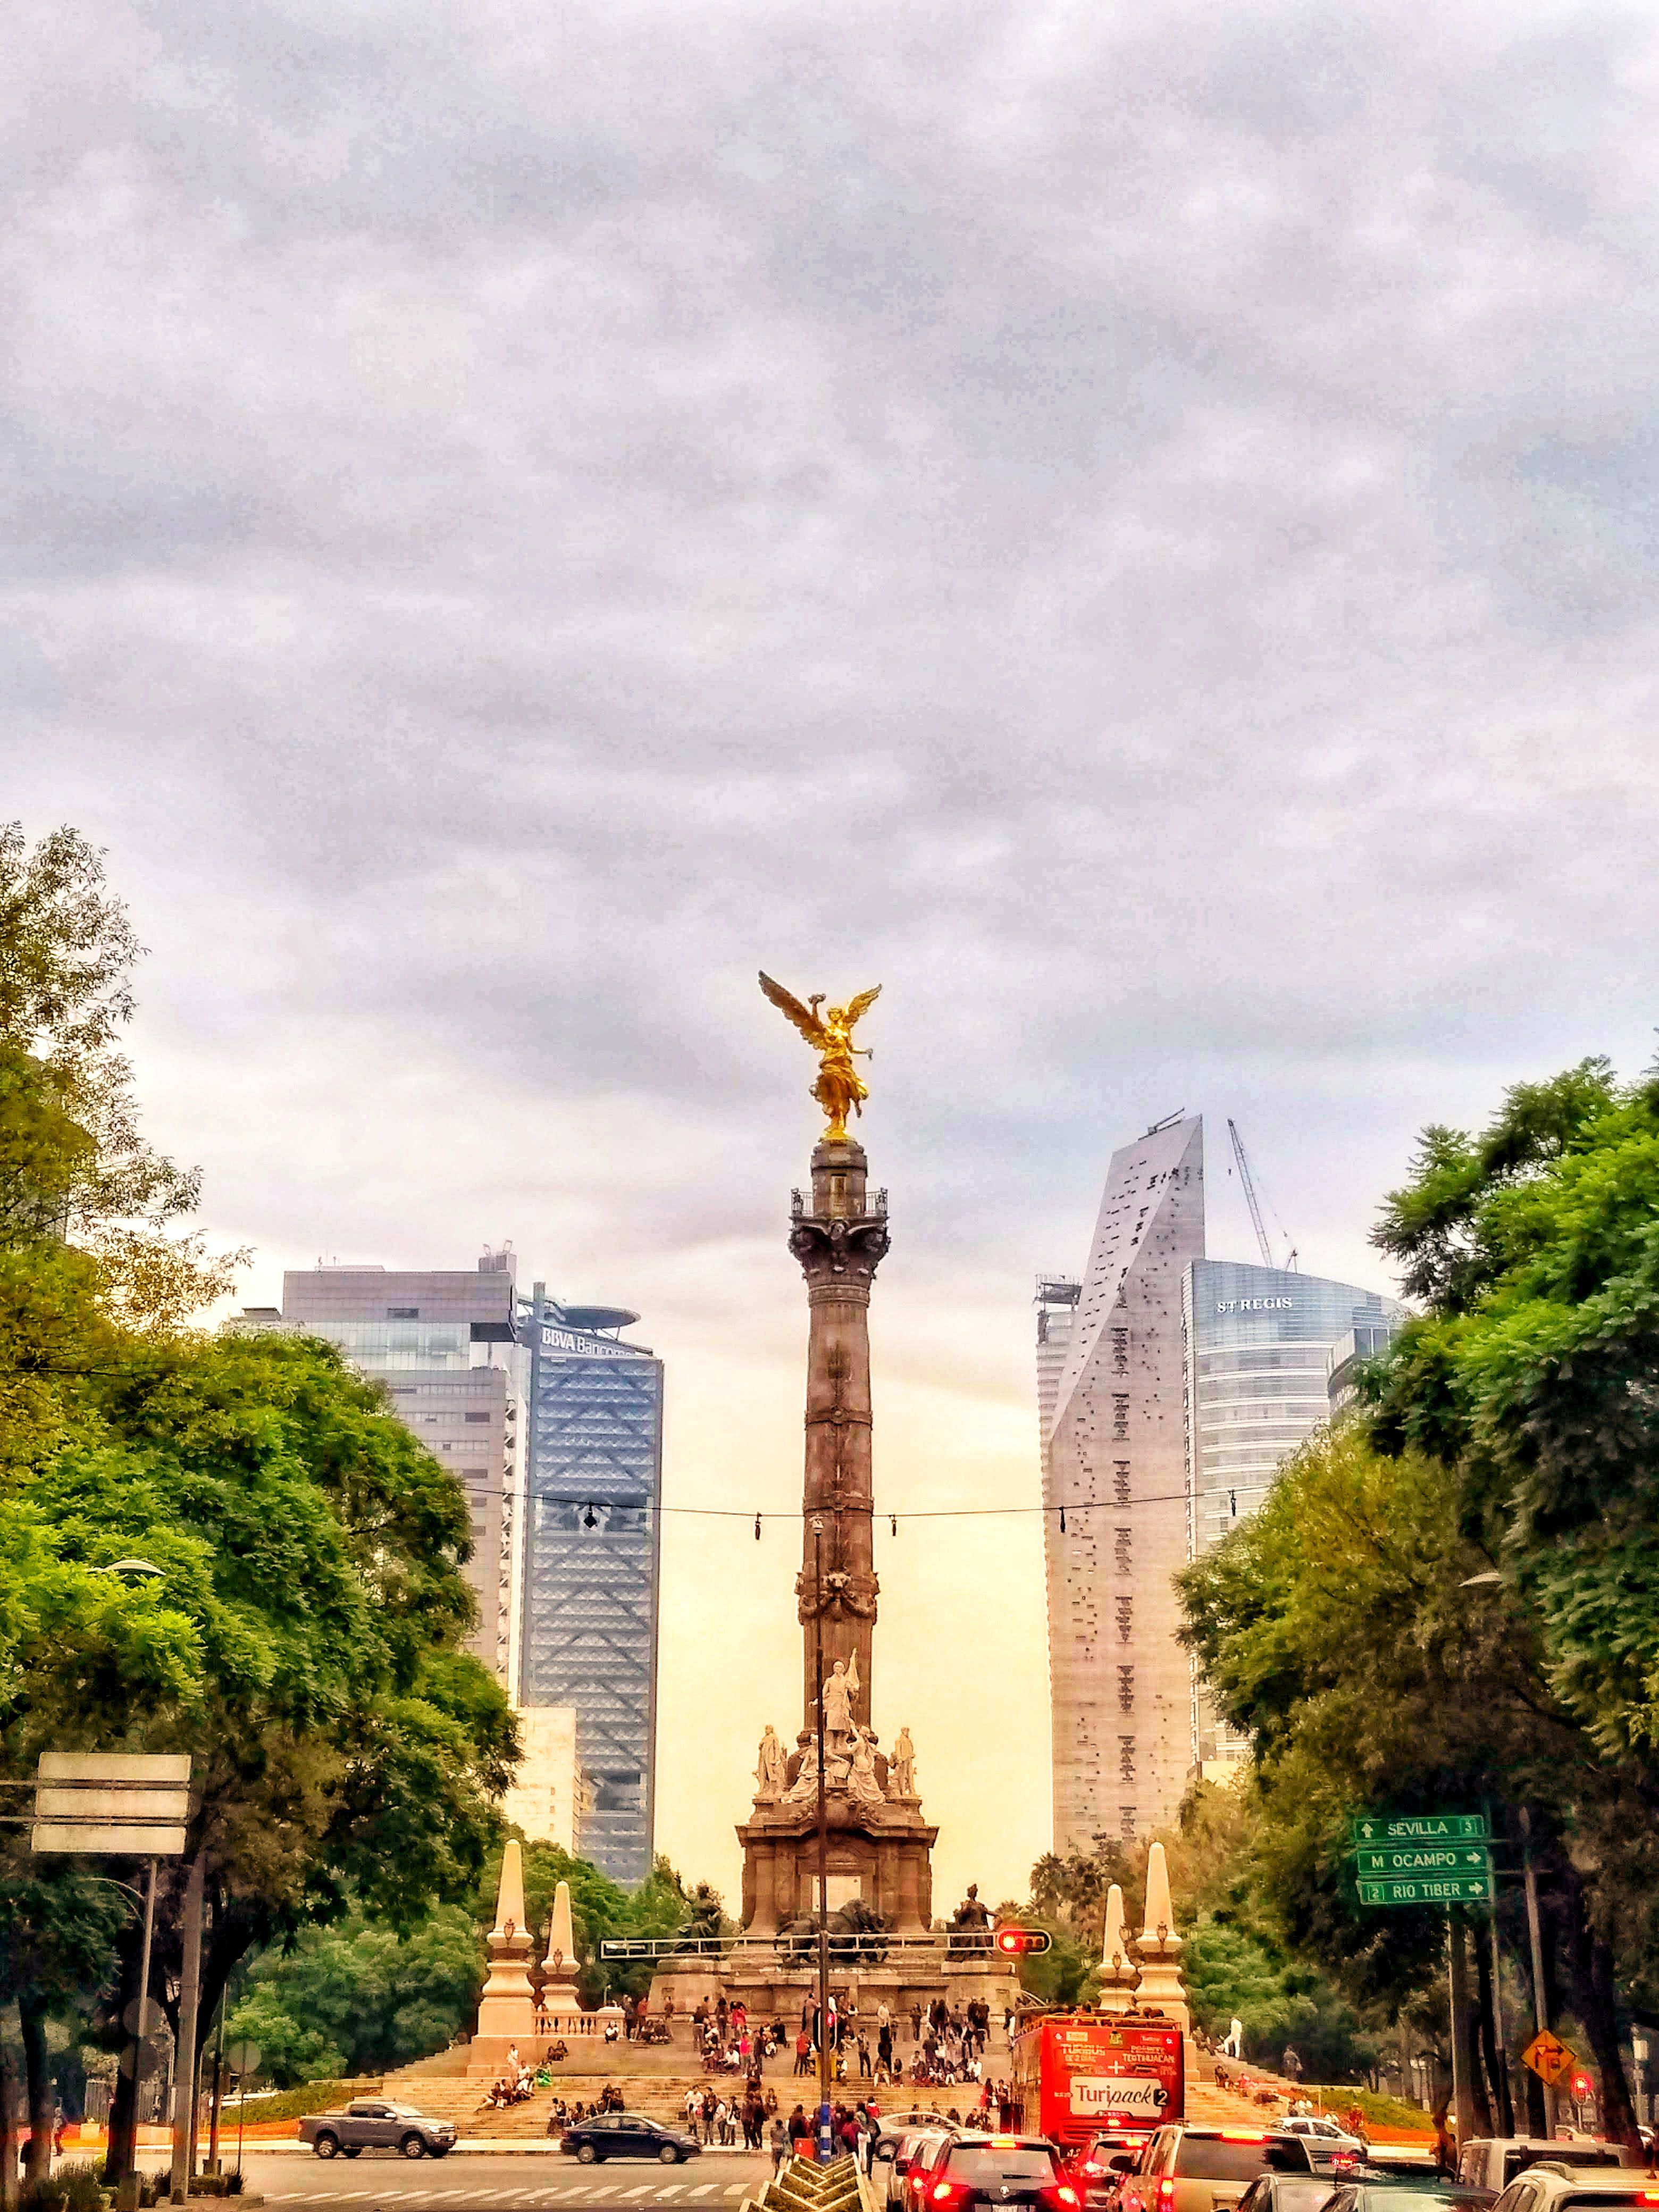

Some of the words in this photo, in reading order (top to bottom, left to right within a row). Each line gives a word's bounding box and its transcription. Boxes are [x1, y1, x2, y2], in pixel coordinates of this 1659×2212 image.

[1241, 1297, 1293, 1311] REGIS
[542, 1327, 575, 1351] BBVA
[1387, 1821, 1448, 1836] SEVILLA
[1371, 1855, 1384, 1868] M
[1393, 1853, 1456, 1867] OCAMPO
[1372, 1888, 1379, 1899] 2
[1393, 1884, 1415, 1898] RIO
[1421, 1883, 1461, 1897] TIBER
[1075, 2084, 1151, 2107] Turipack
[1157, 2090, 1168, 2106] 2
